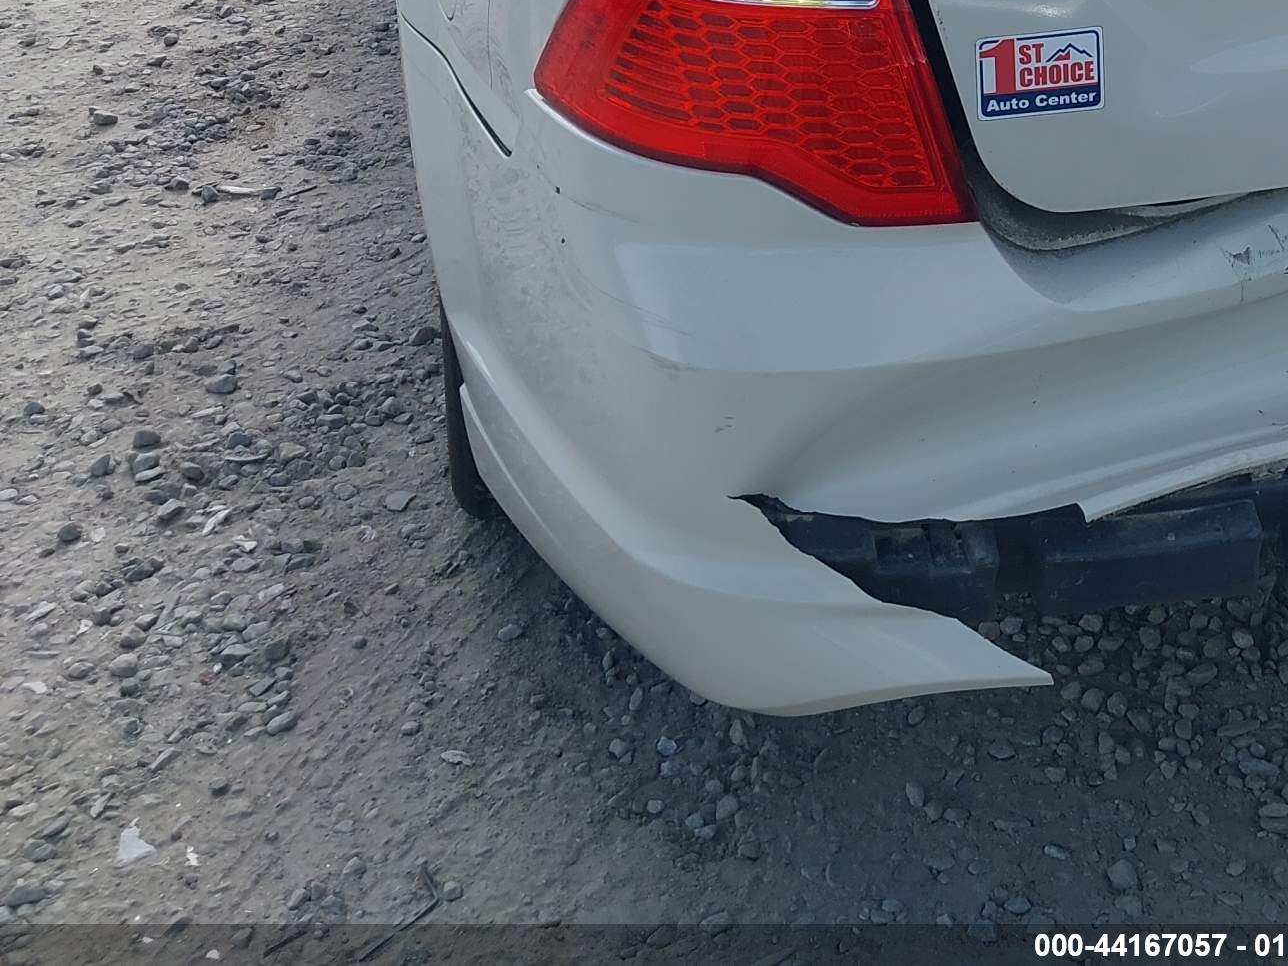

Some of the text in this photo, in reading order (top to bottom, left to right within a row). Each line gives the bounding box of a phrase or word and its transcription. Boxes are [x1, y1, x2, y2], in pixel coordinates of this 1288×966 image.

[1019, 60, 1095, 88] CHOICE
[986, 92, 1096, 112] Auto Center
